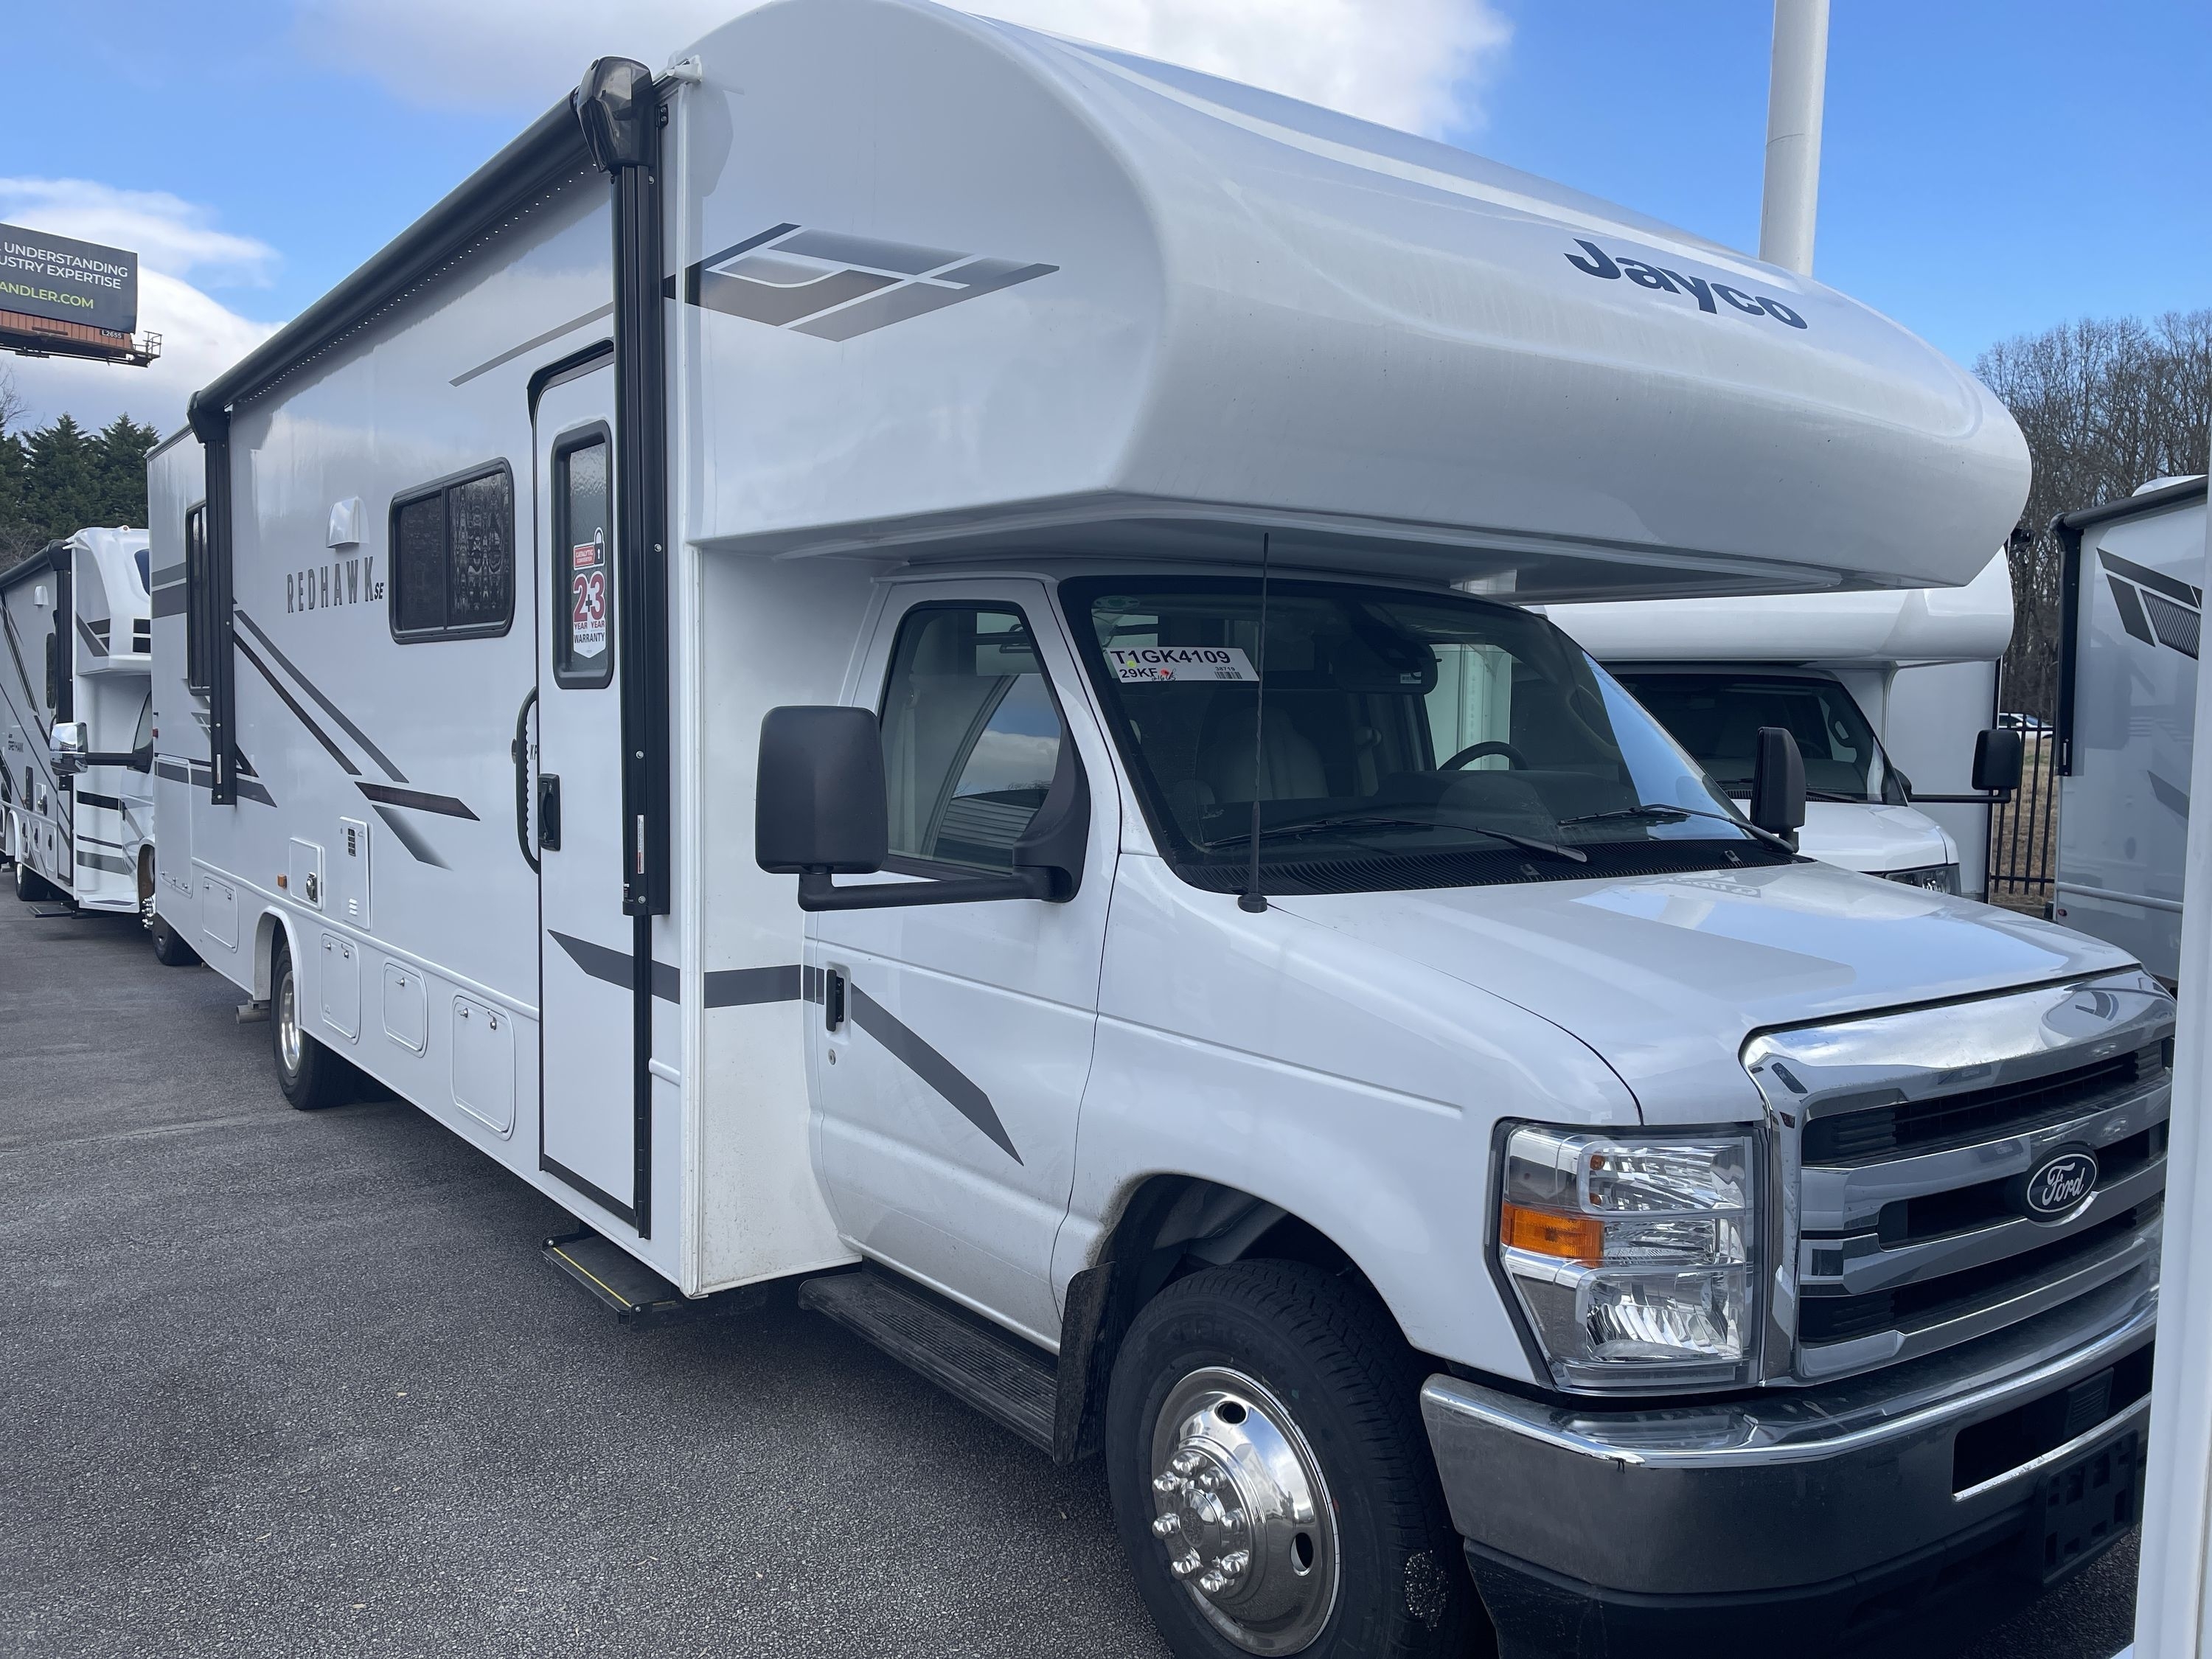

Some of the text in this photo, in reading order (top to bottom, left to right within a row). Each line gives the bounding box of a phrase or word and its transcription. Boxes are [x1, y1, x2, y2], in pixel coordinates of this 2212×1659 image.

[4, 241, 128, 278] UNDERSTANDING
[46, 265, 122, 290] EXPERTISE
[1563, 237, 1808, 330] Jayco
[287, 556, 384, 613] REDHAWK SE
[574, 620, 605, 630] YEAR YEAR
[574, 632, 605, 644] WARRANTY
[1110, 650, 1231, 664] T1GK4109
[1119, 667, 1158, 678] 29KF
[2042, 1162, 2086, 1206] Ford
